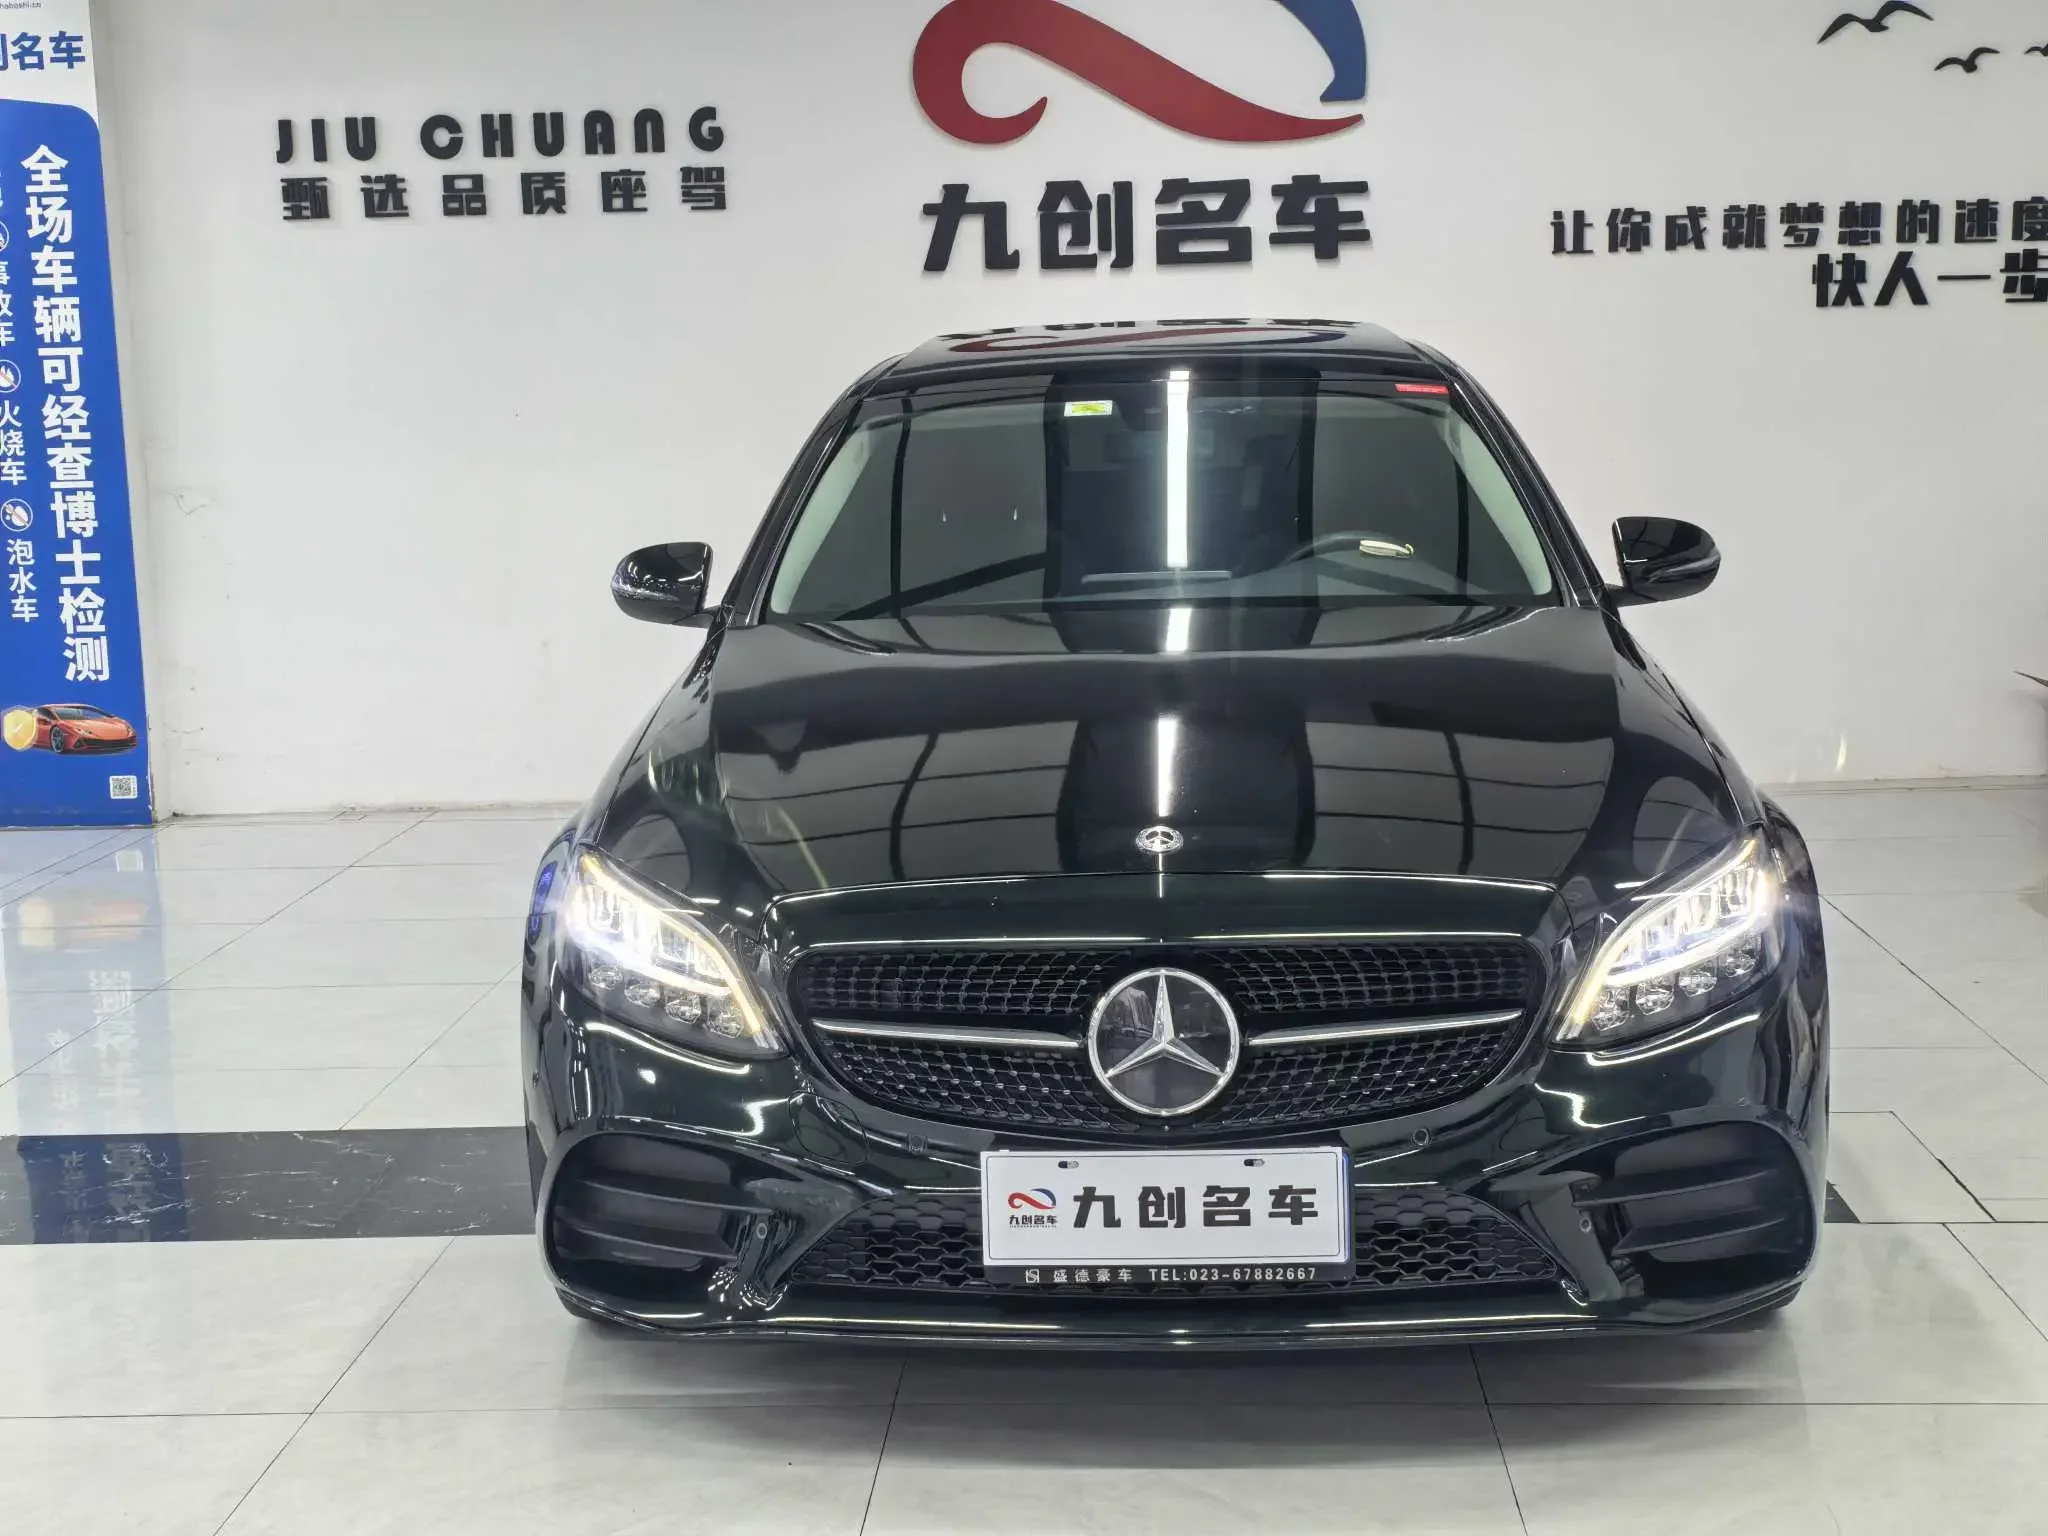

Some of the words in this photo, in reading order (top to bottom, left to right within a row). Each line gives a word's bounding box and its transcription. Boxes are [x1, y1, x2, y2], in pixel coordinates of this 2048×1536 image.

[275, 116, 377, 164] JIU
[420, 106, 725, 161] CHUANG
[280, 166, 727, 221] 甄选品质座驾
[922, 174, 1371, 271] 九创名车
[1550, 196, 2048, 254] 让你成就梦想的速度
[1811, 248, 2048, 307] 快人一步
[20, 144, 110, 682] 全场车辆可经查博士检测
[0, 400, 28, 486] 火烧车
[6, 538, 40, 623] 泡水车
[1009, 1214, 1058, 1225] 九创名车
[1073, 1185, 1319, 1229] 九创名车
[1053, 1268, 1133, 1283] 盛德豪车
[1149, 1267, 1317, 1282] TEL:023-67882667
